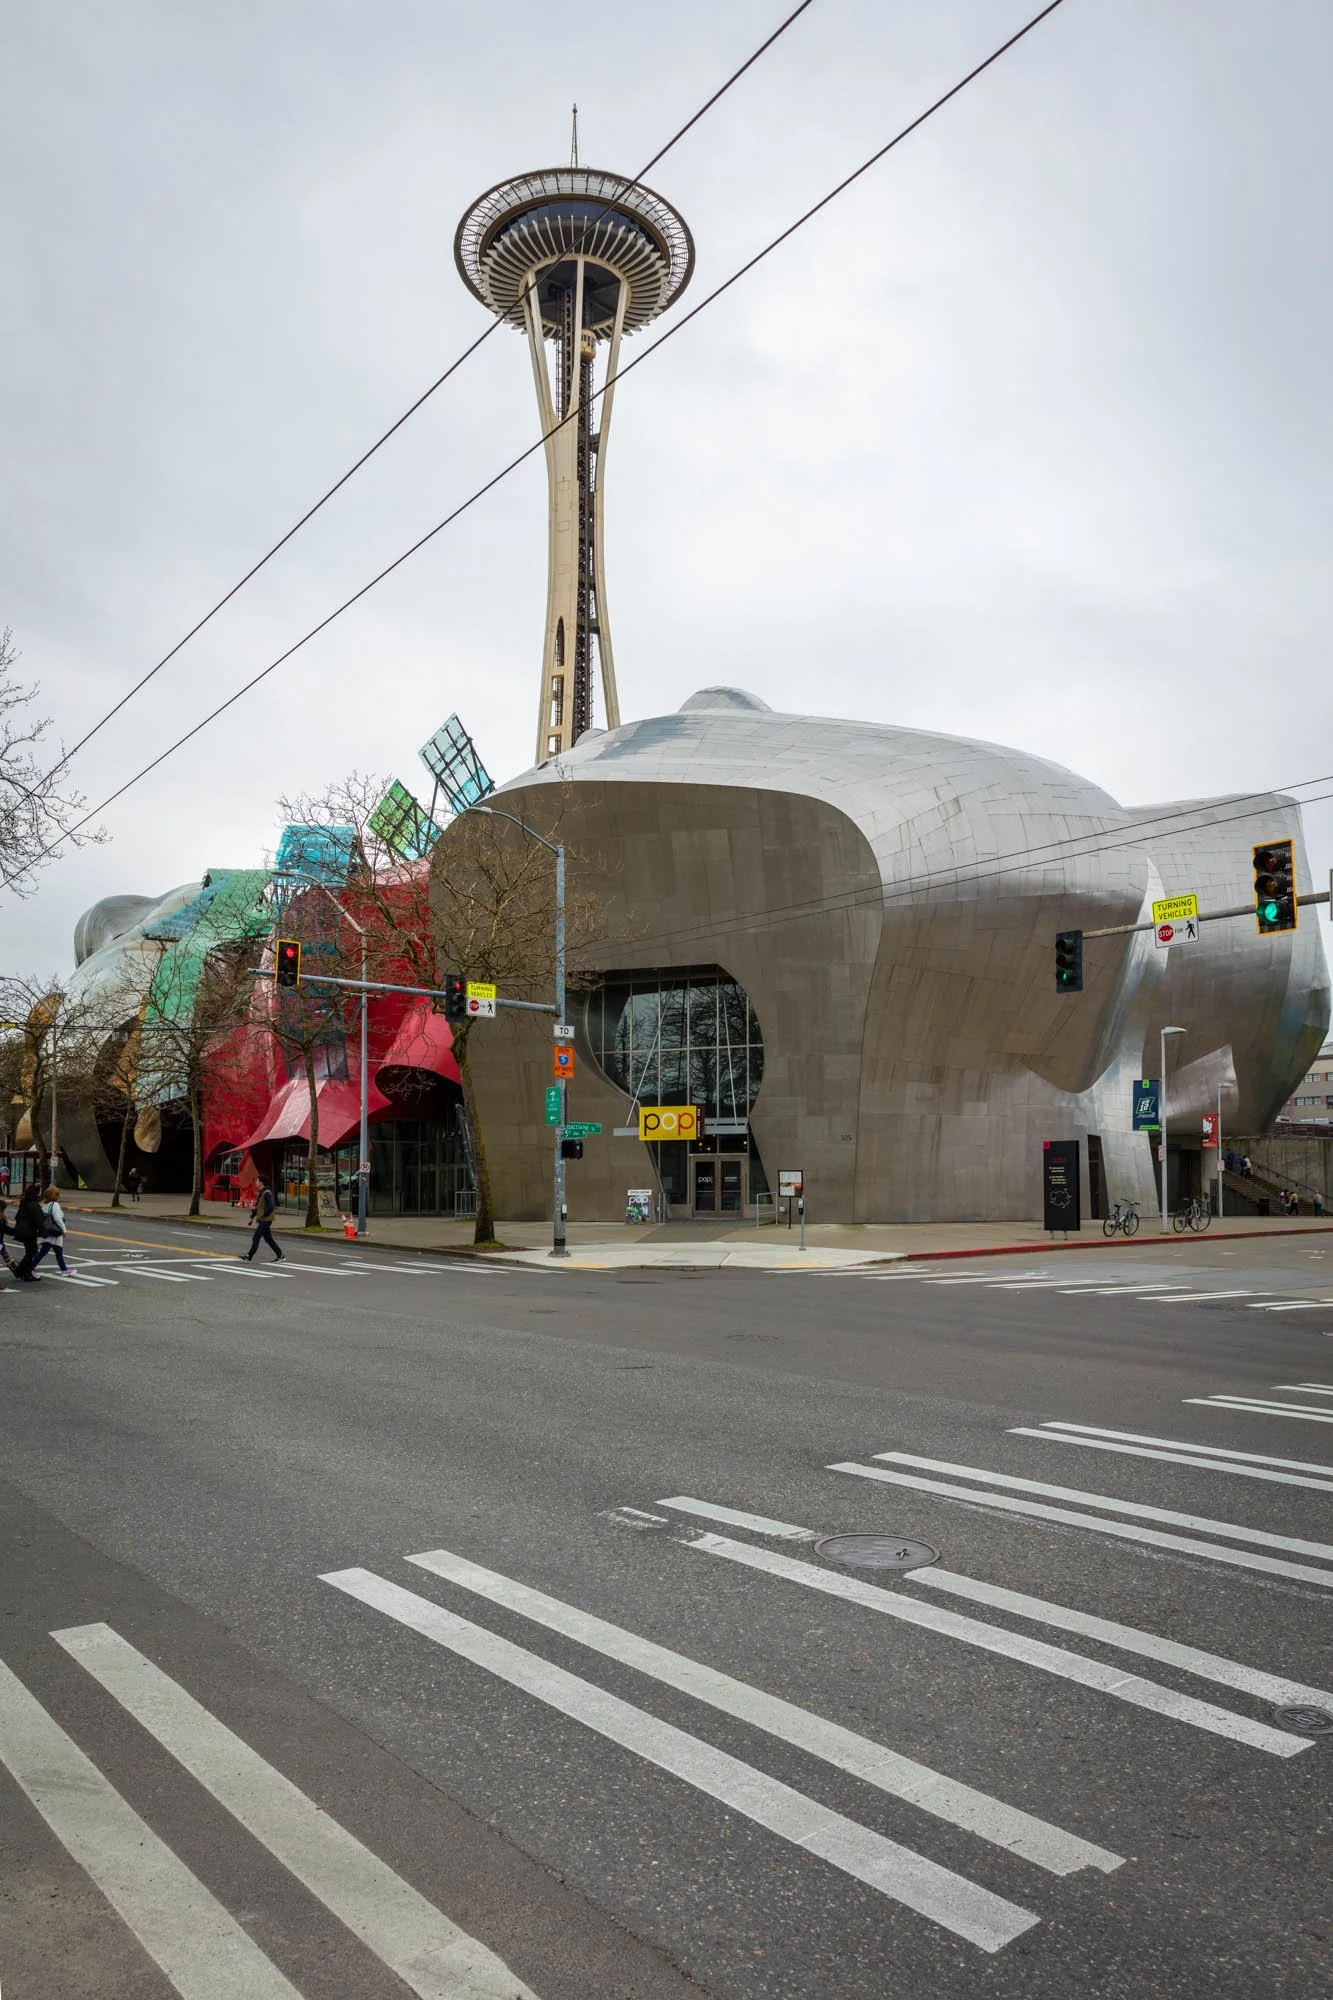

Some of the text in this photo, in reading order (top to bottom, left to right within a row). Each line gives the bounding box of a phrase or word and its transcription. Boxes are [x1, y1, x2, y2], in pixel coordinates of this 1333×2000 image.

[1157, 899, 1192, 911] TURNING
[1158, 908, 1192, 920] VEHICLES
[470, 984, 493, 992] TURNING
[560, 1027, 569, 1035] TO
[1139, 1103, 1150, 1112] 12
[644, 1112, 694, 1137] pop
